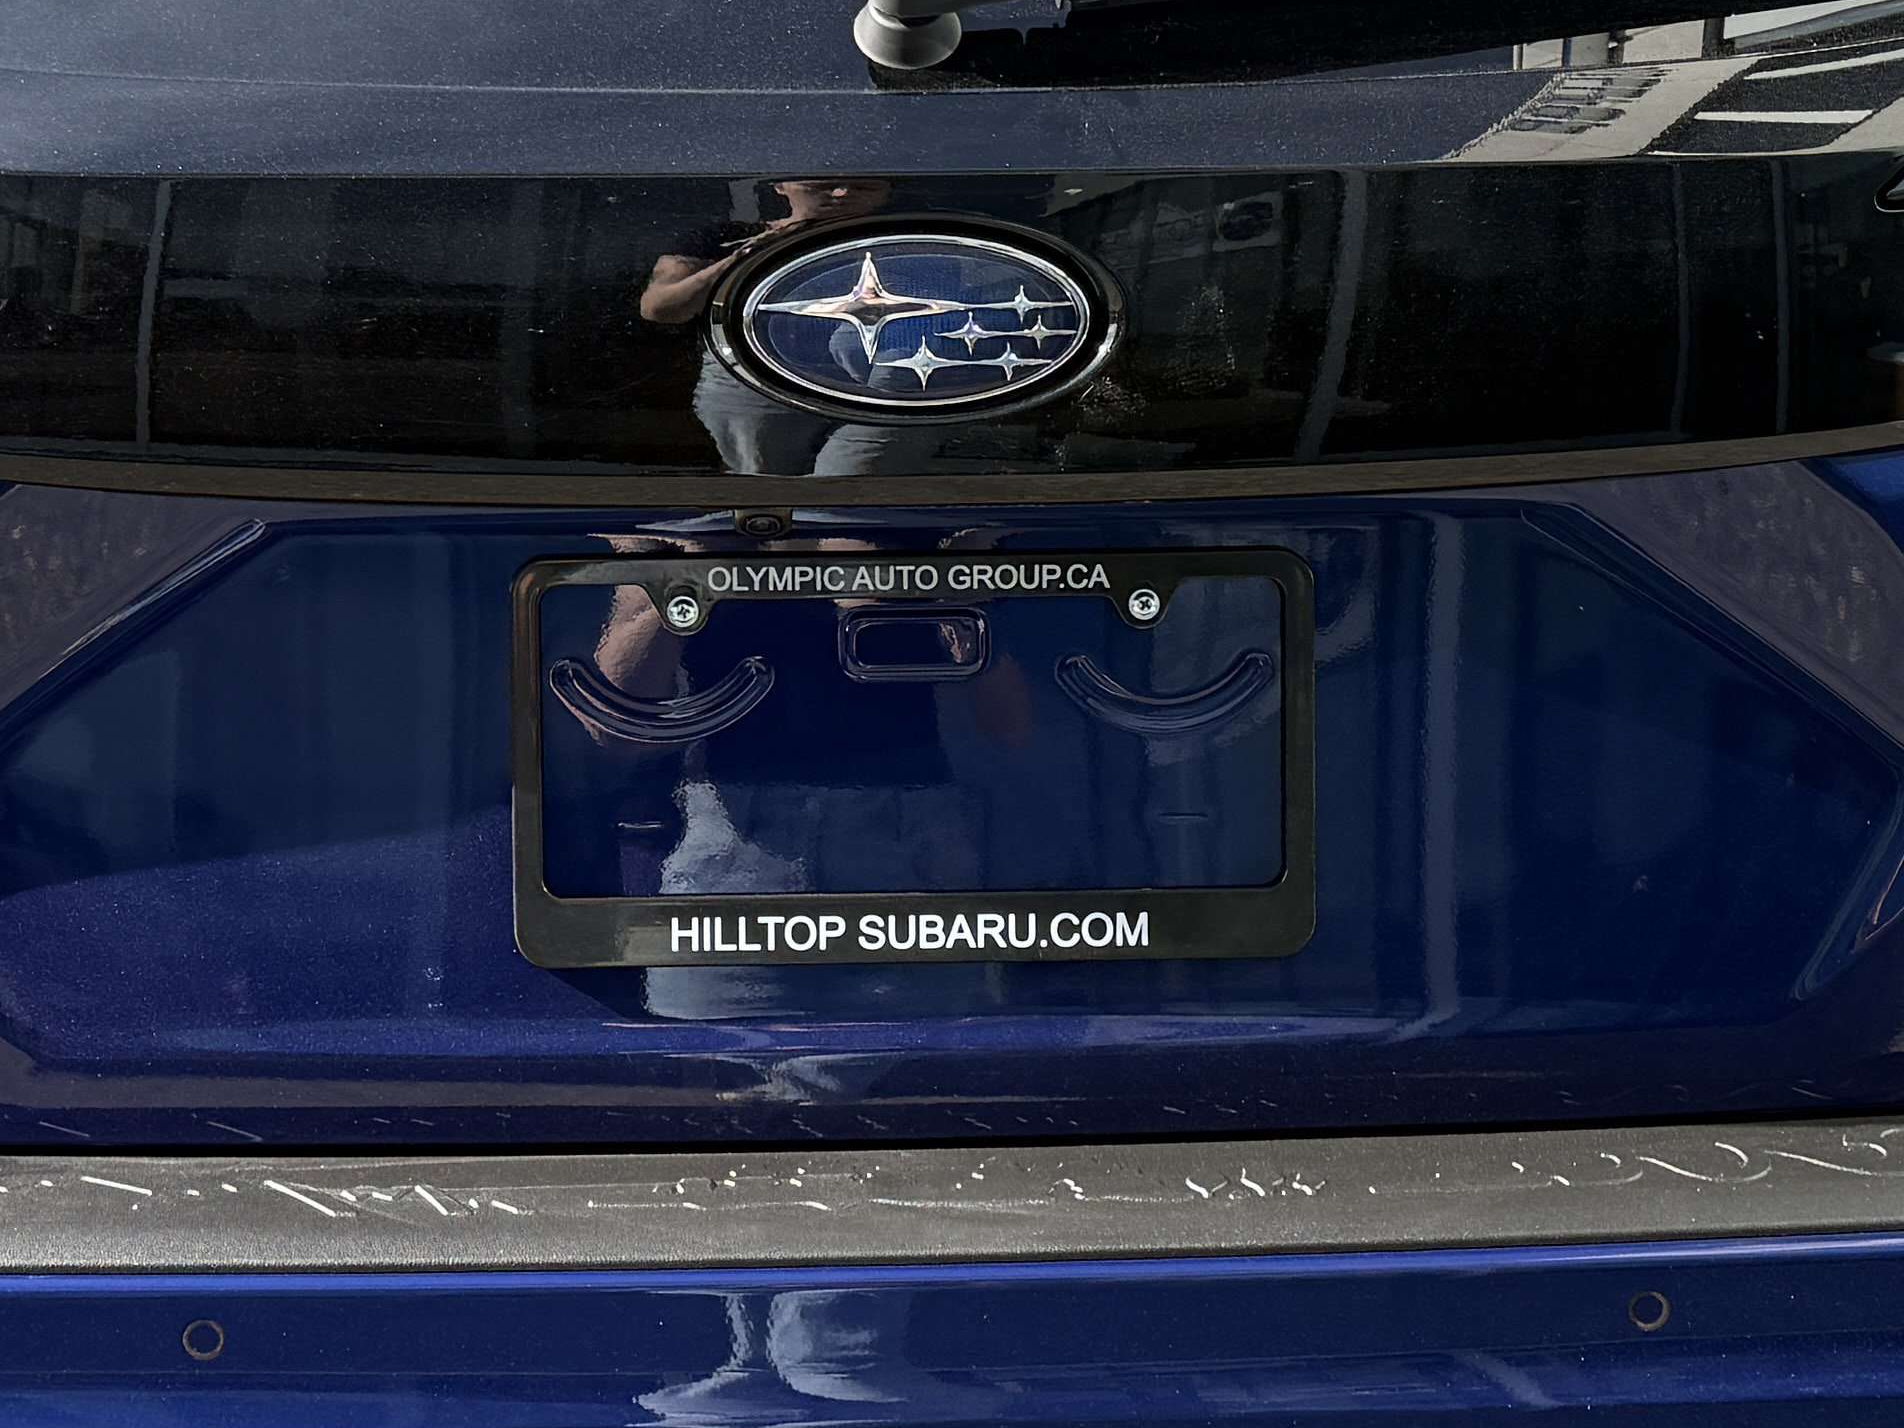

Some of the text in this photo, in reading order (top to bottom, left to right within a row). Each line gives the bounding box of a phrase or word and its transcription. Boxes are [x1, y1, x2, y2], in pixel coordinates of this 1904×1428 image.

[707, 564, 1110, 592] OLYMPIC AUTO GROUP.CA
[670, 911, 1149, 952] HILLTOP SUBARU.COM
